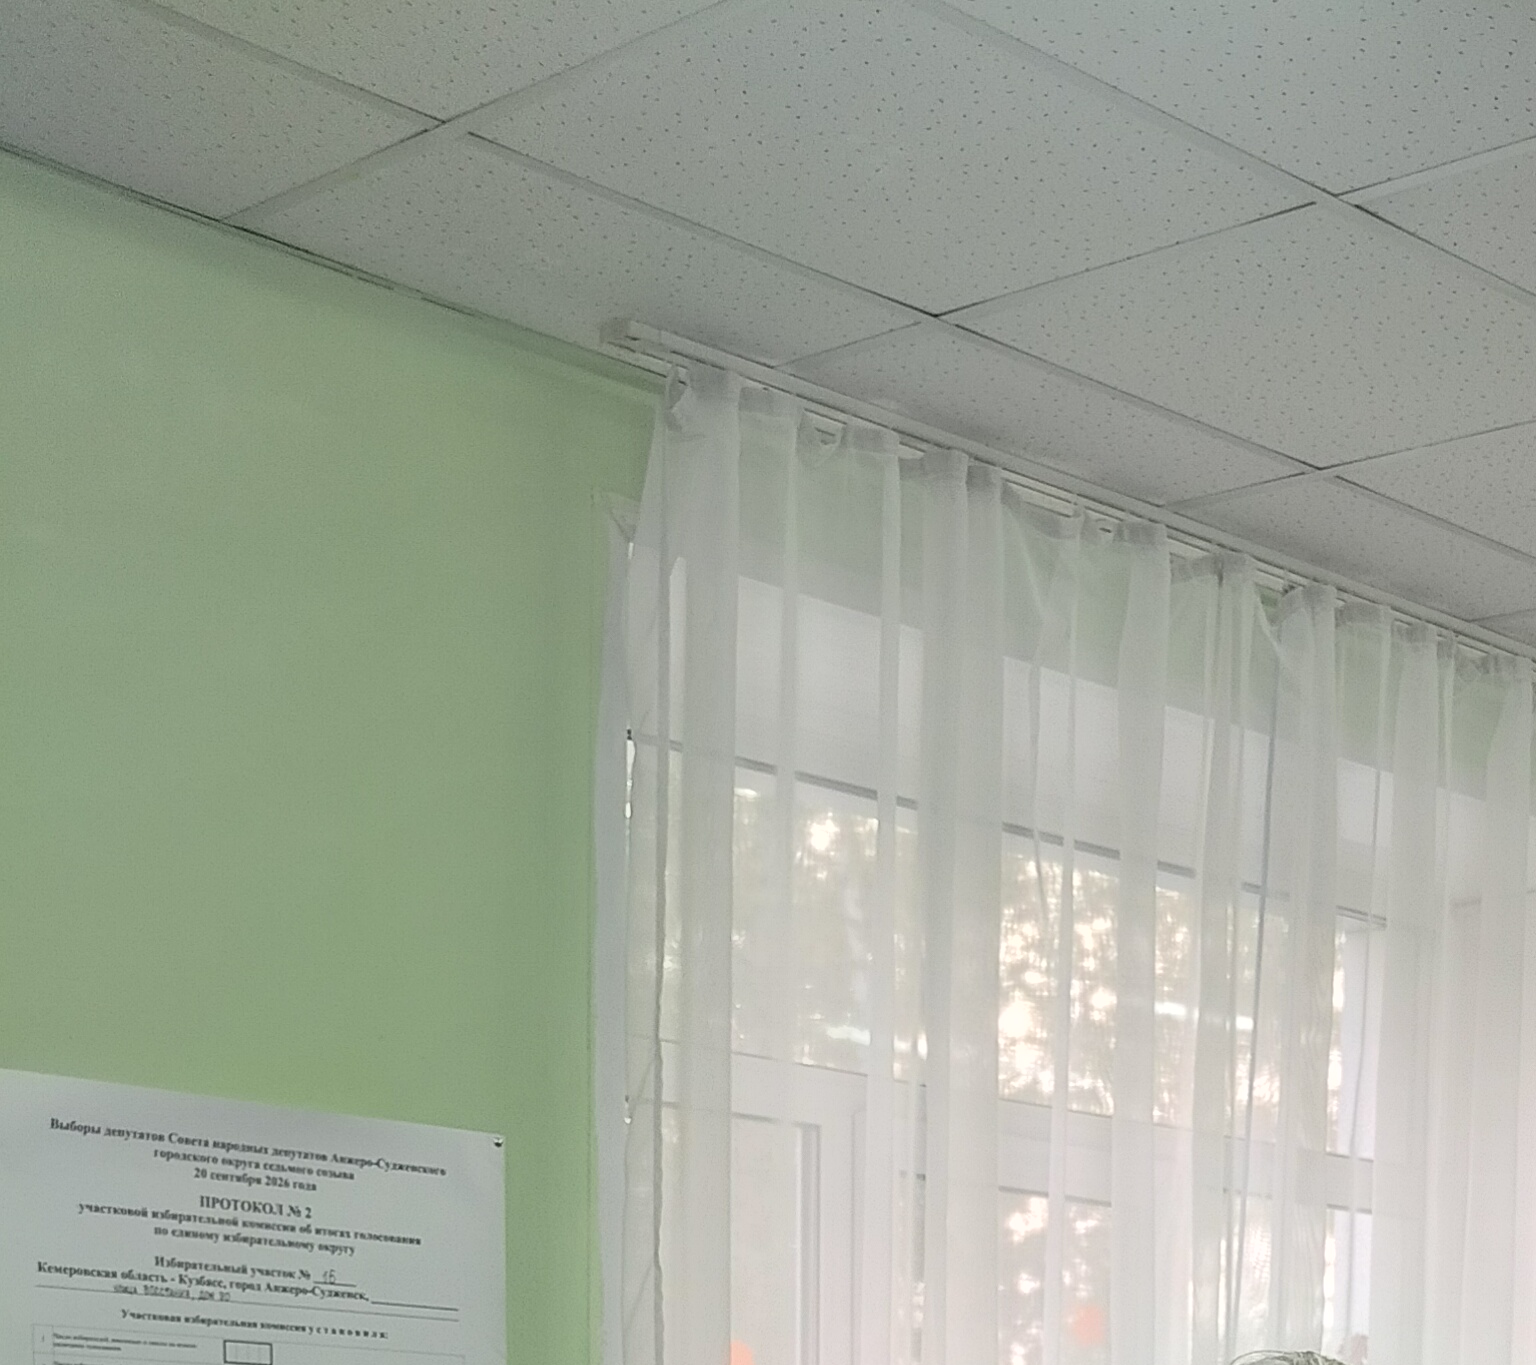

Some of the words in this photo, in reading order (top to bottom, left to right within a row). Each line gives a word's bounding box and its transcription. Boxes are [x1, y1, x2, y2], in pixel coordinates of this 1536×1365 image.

[50, 1118, 101, 1135] Выборы
[104, 1126, 165, 1142] депутатов
[168, 1132, 209, 1147] Совета
[213, 1139, 269, 1155] народных
[271, 1147, 328, 1163] депутатов
[153, 1149, 218, 1164] городского
[221, 1156, 260, 1170] округа
[263, 1162, 313, 1176] седьмого
[316, 1168, 354, 1180] созыва
[194, 1167, 207, 1179] 20
[210, 1170, 262, 1186] сентября
[265, 1175, 290, 1188] 2026
[292, 1181, 317, 1192] года
[200, 1195, 283, 1216] ПРОТОКОЛ
[287, 1204, 301, 1217] №
[305, 1207, 312, 1219] 2
[78, 1202, 148, 1218] участковой
[152, 1208, 238, 1227] избирательной
[242, 1219, 296, 1232] комиссии
[299, 1223, 312, 1235] об
[315, 1227, 350, 1239] итогах
[354, 1231, 421, 1246] голосования
[154, 1226, 168, 1236] по
[171, 1229, 220, 1243] единому
[223, 1233, 315, 1253] избирательному
[318, 1243, 355, 1256] округу
[37, 1261, 118, 1279] Кемеровская
[121, 1269, 168, 1284] область
[178, 1274, 227, 1290] Кузбасс,
[229, 1280, 261, 1292] город
[265, 1282, 370, 1302] Анжеро-Судженск,
[154, 1256, 248, 1275] Избирательный
[250, 1266, 296, 1280] участок
[298, 1269, 311, 1280] №
[122, 1309, 181, 1323] Участковая
[184, 1315, 258, 1328] избирательная
[260, 1321, 306, 1333] комиссия
